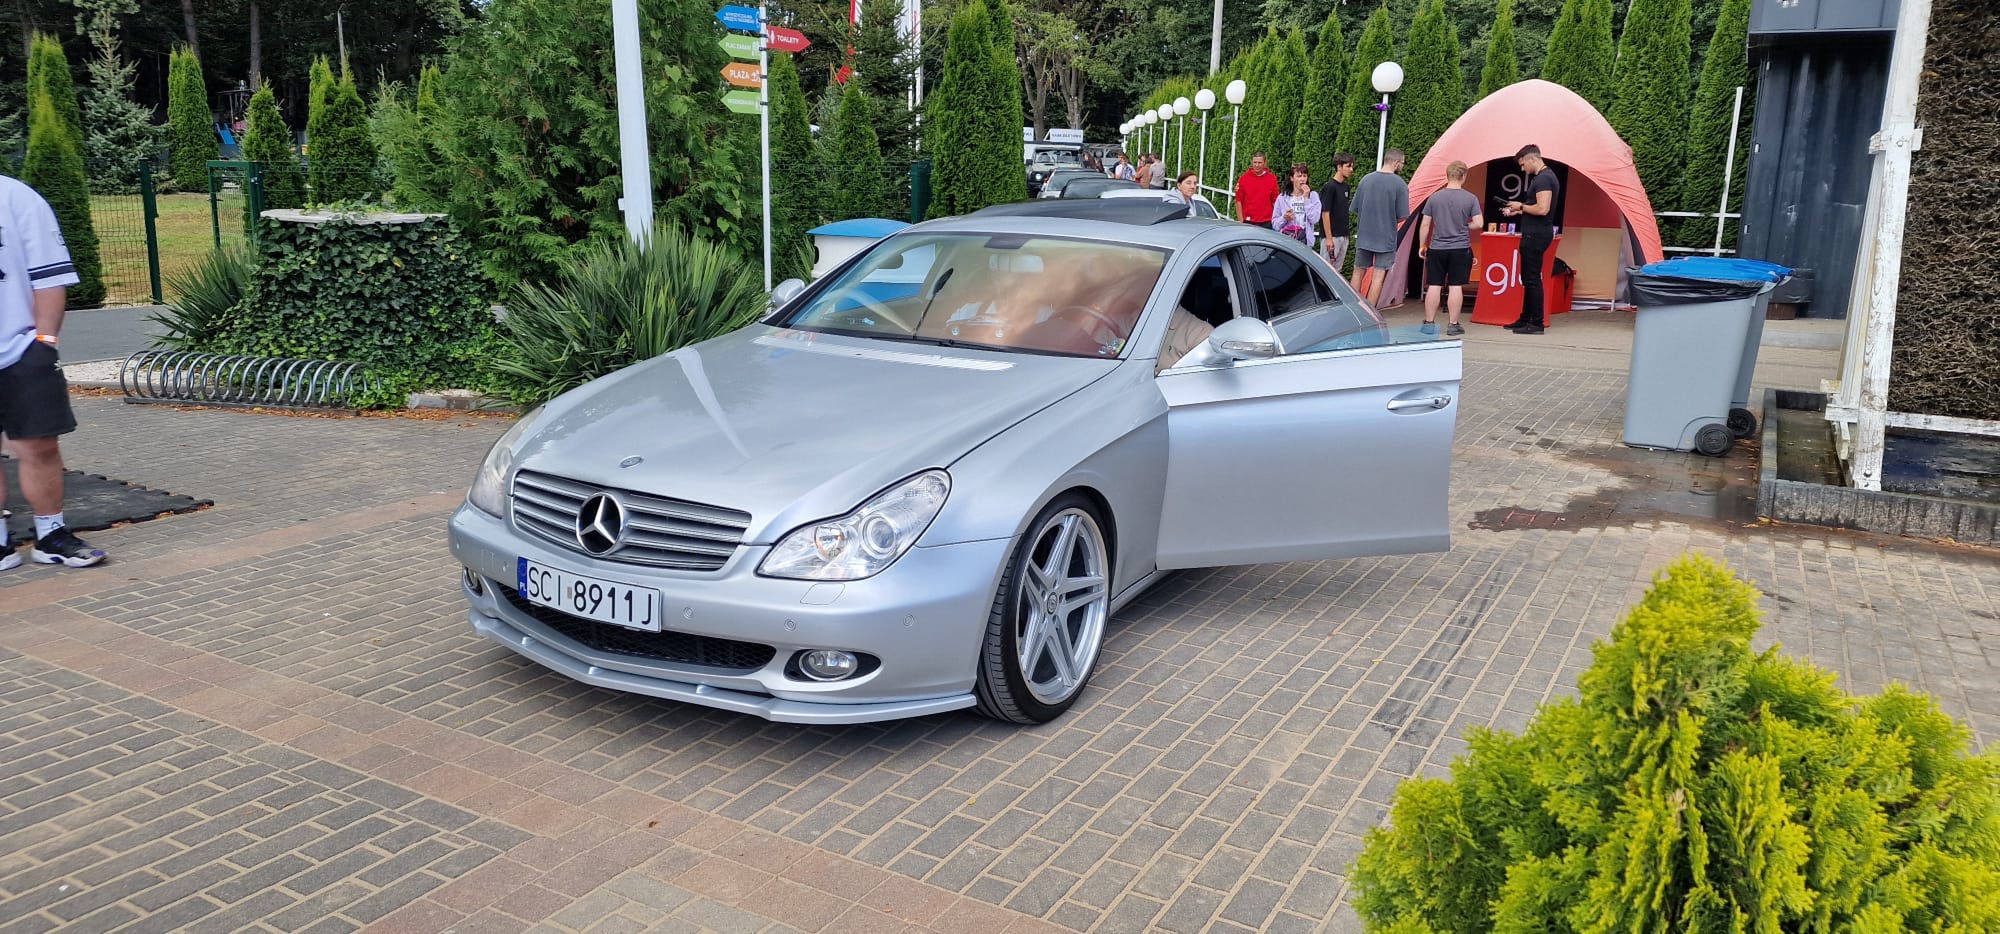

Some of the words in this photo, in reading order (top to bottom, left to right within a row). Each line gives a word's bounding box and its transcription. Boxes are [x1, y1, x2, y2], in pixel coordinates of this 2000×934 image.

[776, 34, 800, 45] TOALETY
[729, 69, 750, 79] PLAZA
[1501, 172, 1530, 199] gl
[1485, 248, 1523, 295] gl
[519, 581, 527, 592] PL
[528, 566, 561, 606] SCI
[573, 580, 652, 625] 8911J
